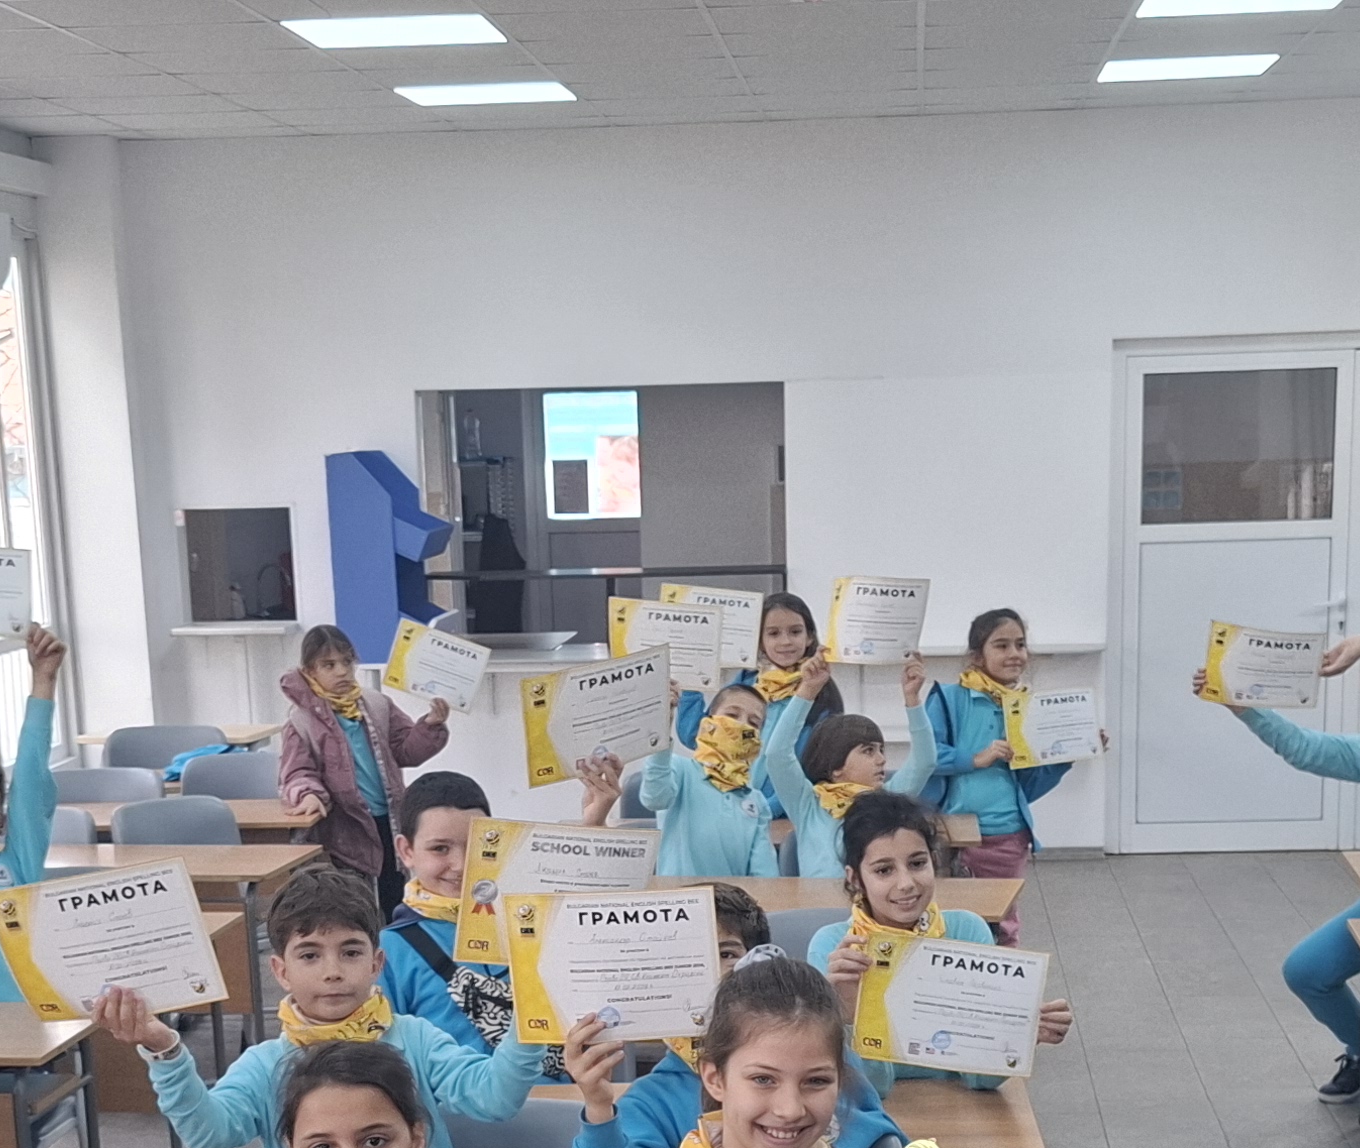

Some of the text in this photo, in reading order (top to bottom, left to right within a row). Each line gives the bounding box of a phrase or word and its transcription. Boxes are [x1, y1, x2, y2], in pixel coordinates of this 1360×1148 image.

[856, 586, 916, 598] ГРАМОТА
[696, 596, 750, 609] ГРАМОТА
[648, 611, 709, 624] ГРАМОТА
[430, 638, 478, 661] ГРАМОТА
[1249, 639, 1310, 650] ГРАМОТА
[579, 663, 654, 691] ГРАМОТА
[1040, 695, 1087, 706] ГРАМОТА
[531, 842, 646, 858] SCHOOL WINNER
[58, 880, 168, 912] ГРАМОТА
[579, 908, 689, 925] ГРАМОТА
[931, 954, 1025, 978] ГРАМОТА
